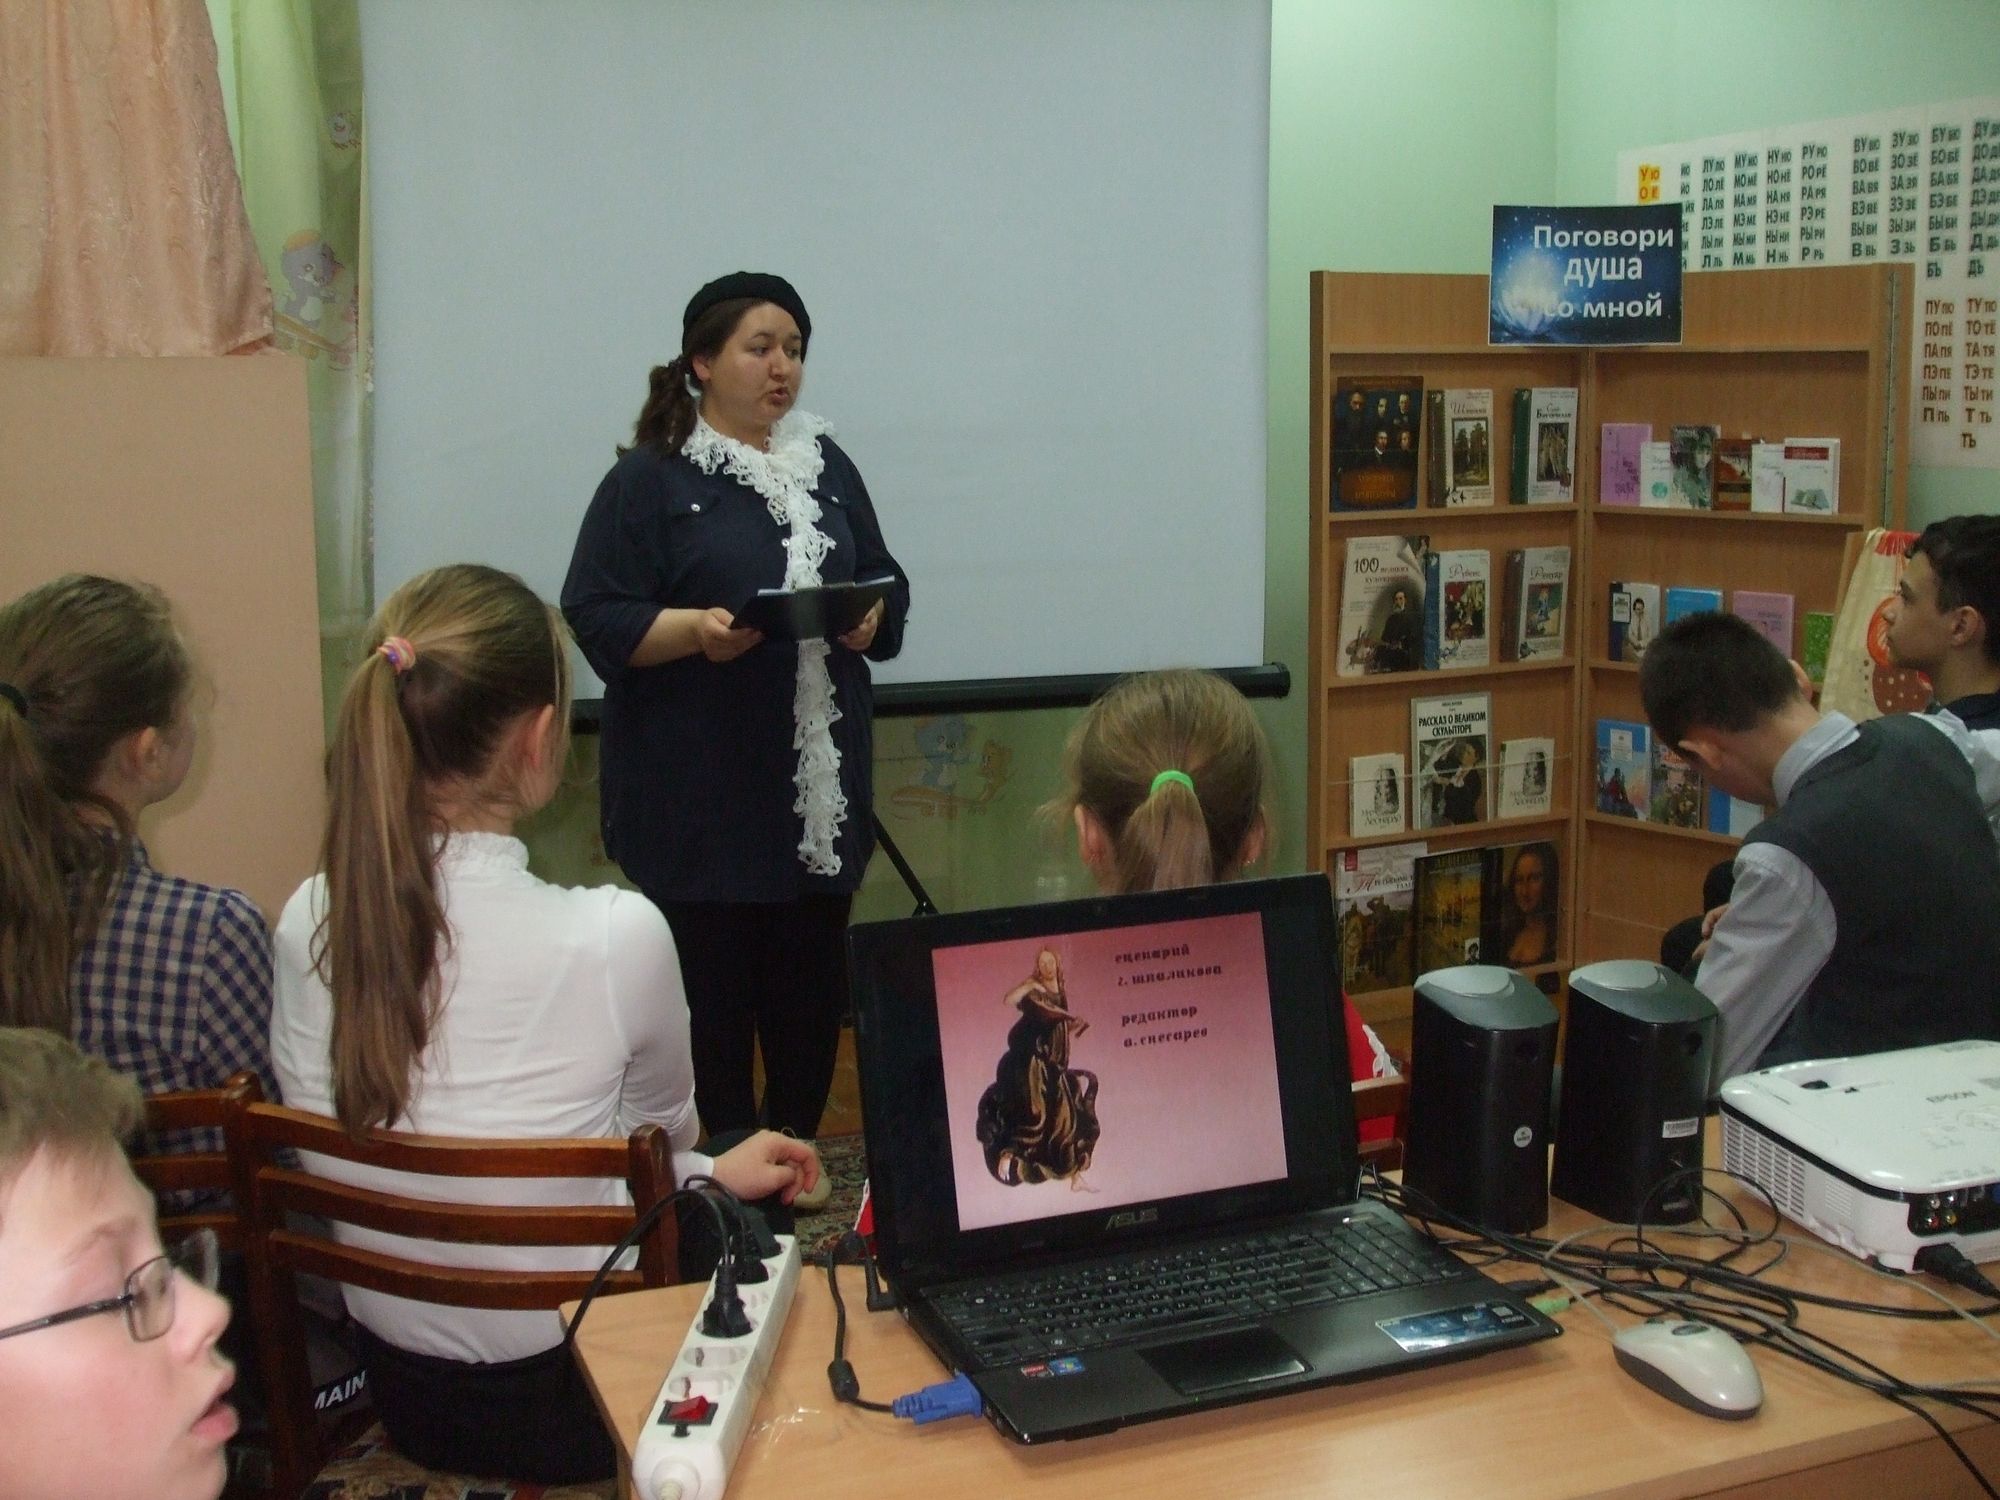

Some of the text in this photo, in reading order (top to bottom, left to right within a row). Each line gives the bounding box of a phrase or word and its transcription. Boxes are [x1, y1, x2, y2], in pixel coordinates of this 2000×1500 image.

[1533, 225, 1674, 251] Поговори
[1563, 255, 1643, 288] душа
[1545, 292, 1662, 318] со мной
[1355, 558, 1379, 573] 100
[1418, 711, 1486, 727] РАССКАЗ О ВЕЛИКОМ
[1115, 944, 1190, 963] сценарий
[1132, 965, 1222, 985] шпаликова
[1121, 1006, 1198, 1027] редактор
